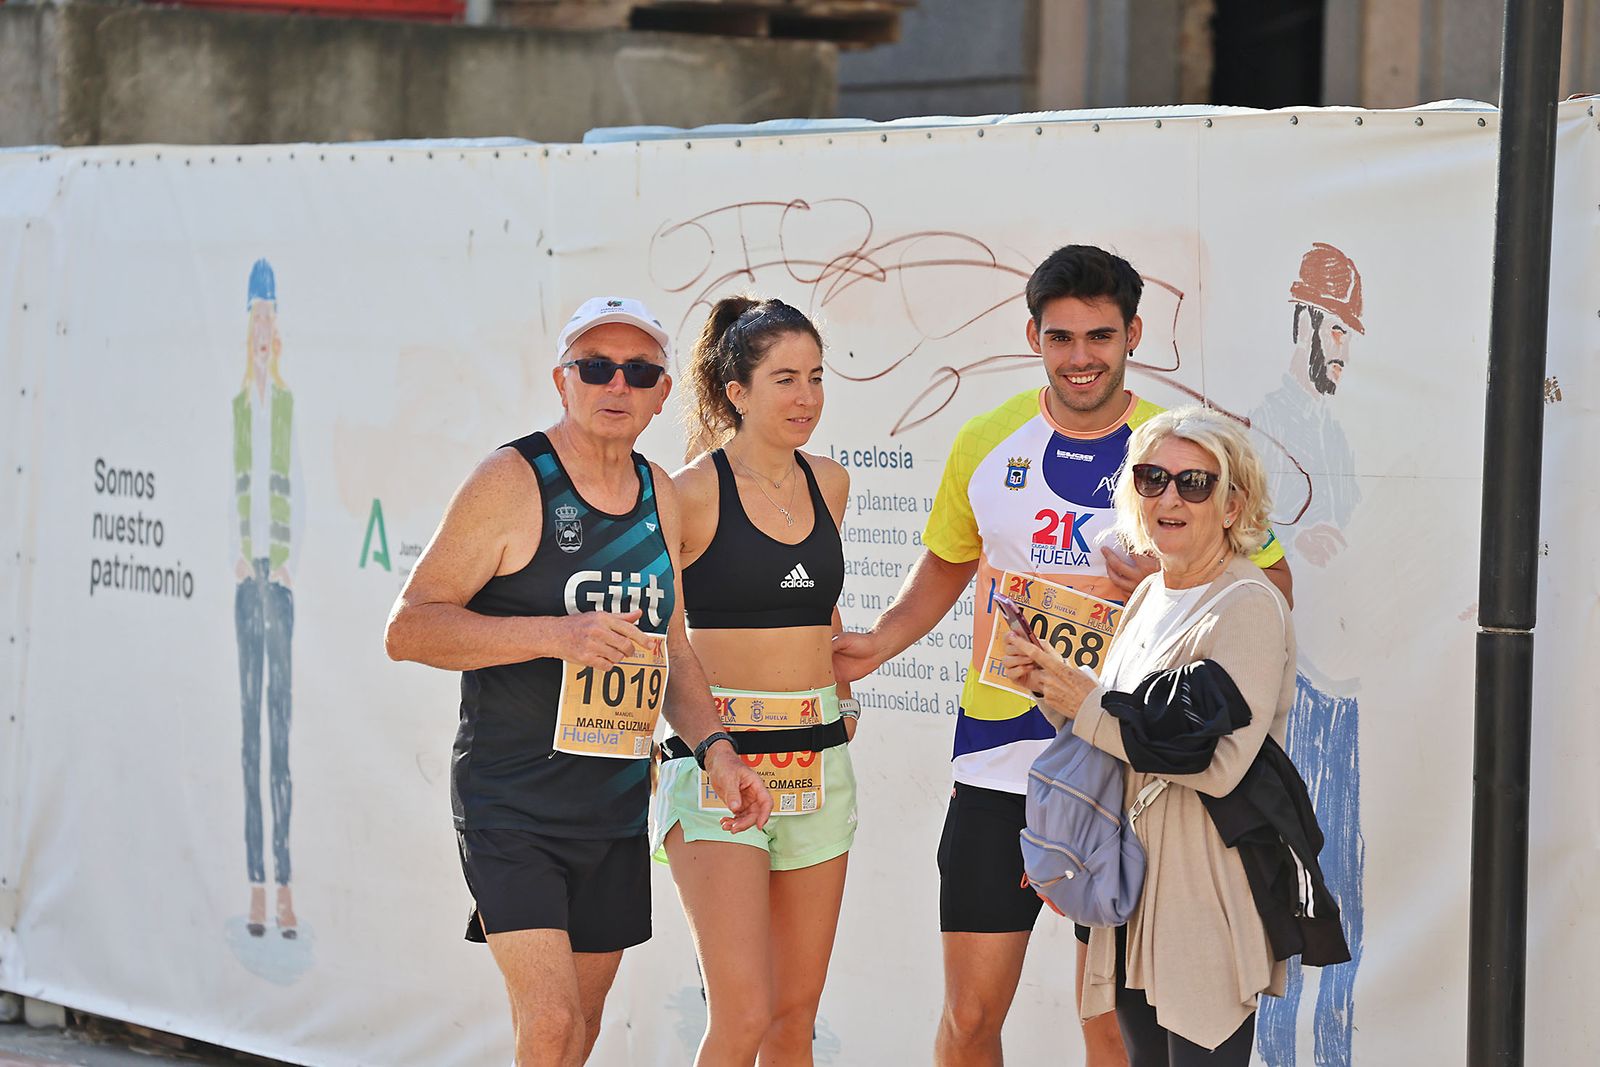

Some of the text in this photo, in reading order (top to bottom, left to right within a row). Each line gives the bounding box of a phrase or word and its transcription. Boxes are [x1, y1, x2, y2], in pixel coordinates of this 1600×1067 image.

[853, 444, 914, 469] celosía
[94, 457, 156, 500] Somos
[857, 489, 918, 516] plantea
[92, 510, 164, 548] nuestro
[842, 521, 907, 546] lemento
[1031, 508, 1095, 553] 21K
[844, 557, 902, 578] arácter
[1030, 548, 1091, 568] HUELVA
[89, 554, 194, 600] patrimonio
[780, 578, 815, 589] adidas
[1009, 576, 1034, 600] 21K
[861, 594, 881, 610] un
[1090, 603, 1119, 627] 21K
[927, 629, 944, 647] se
[1019, 606, 1105, 669] 068
[576, 665, 662, 710] 1019
[940, 668, 951, 682] a
[853, 687, 941, 716] minosidad
[576, 717, 615, 730] MARIN
